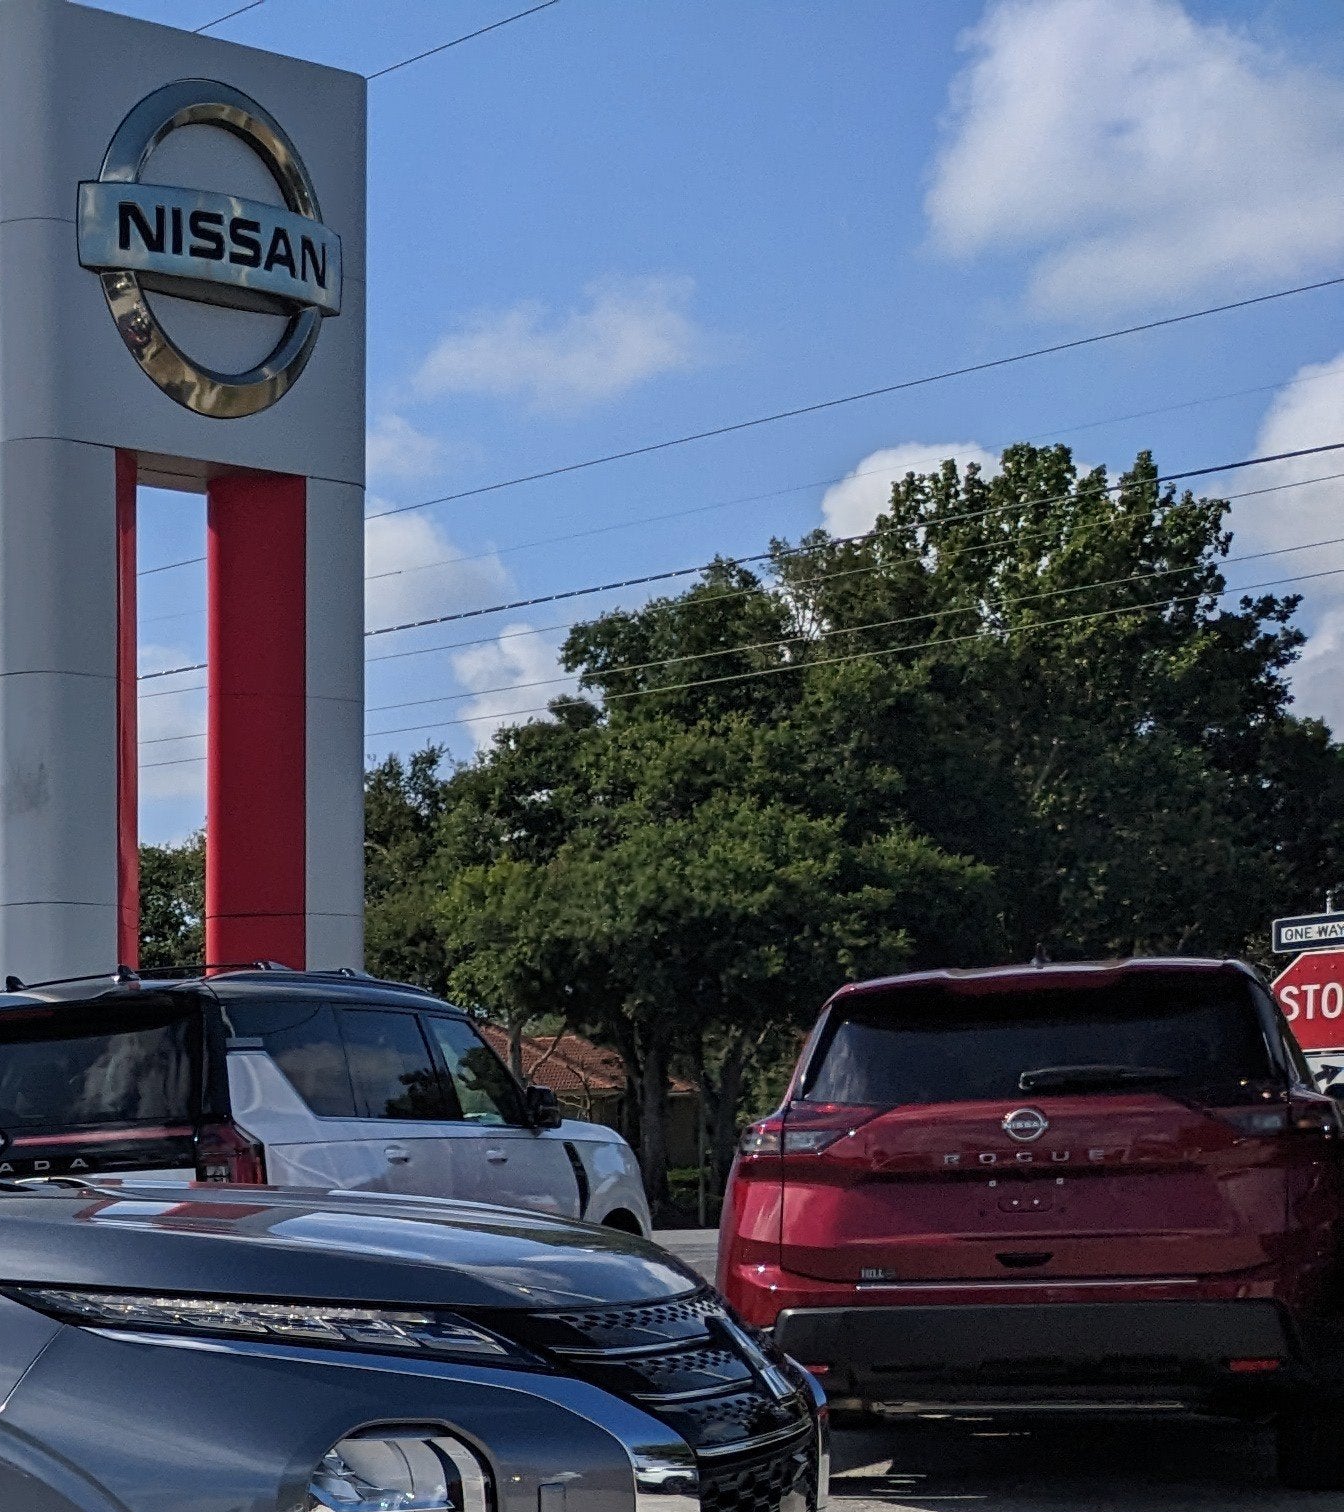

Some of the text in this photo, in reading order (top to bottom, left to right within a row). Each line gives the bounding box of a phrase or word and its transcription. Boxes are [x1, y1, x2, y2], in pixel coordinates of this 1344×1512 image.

[118, 201, 327, 290] NISSAN
[1284, 923, 1344, 941] ONE WAY
[1279, 982, 1344, 1021] STO
[943, 1149, 1105, 1165] ROGUE
